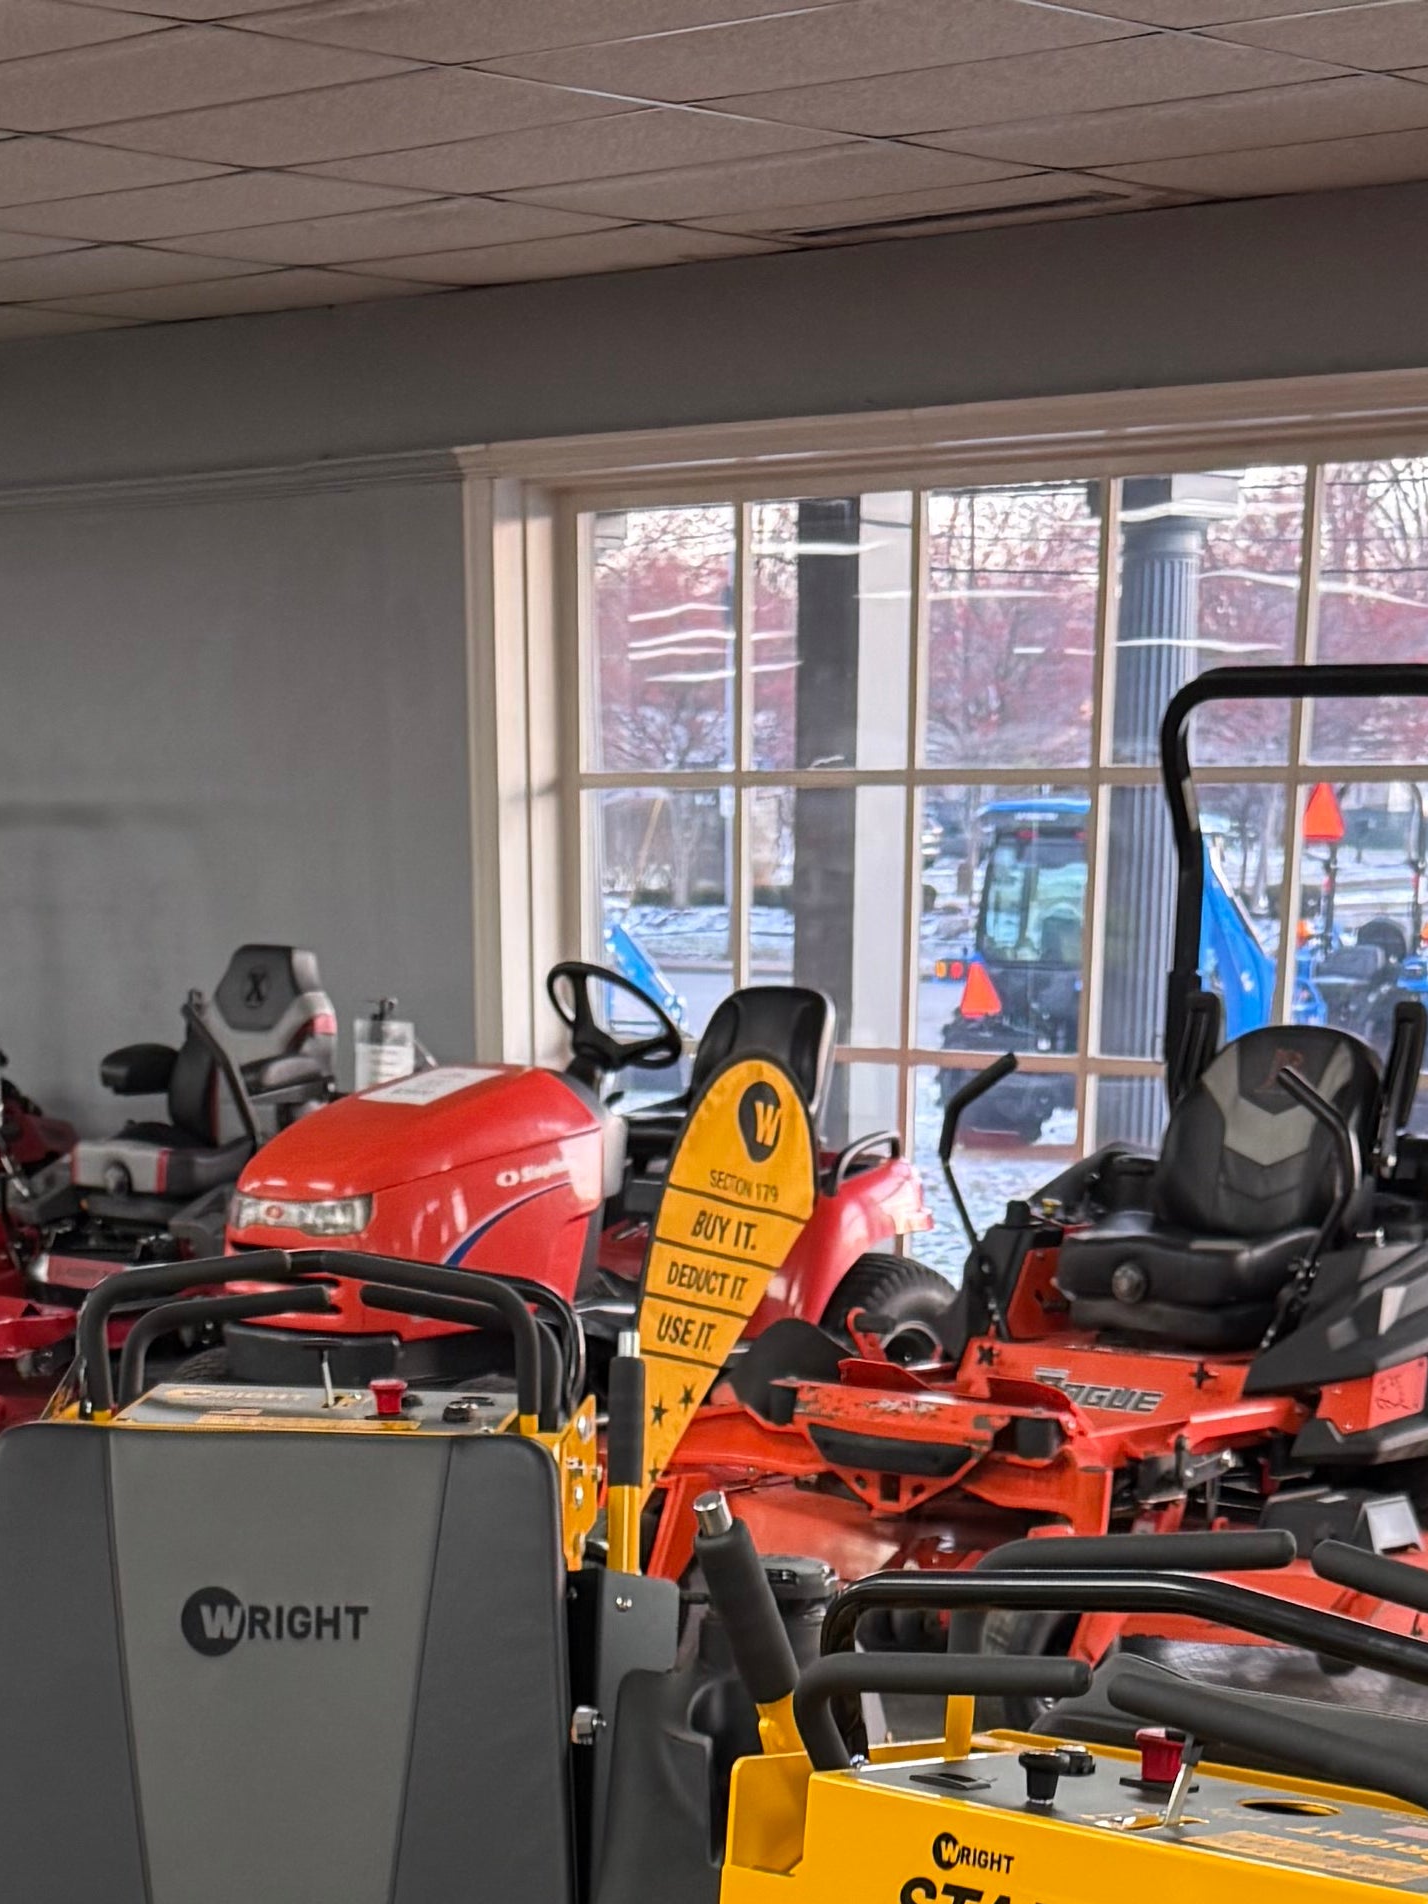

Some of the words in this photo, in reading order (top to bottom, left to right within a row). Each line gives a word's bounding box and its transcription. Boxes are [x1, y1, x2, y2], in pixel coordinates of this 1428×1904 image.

[755, 1182, 779, 1203] 179
[690, 1210, 730, 1242] BUY
[733, 1221, 758, 1251] IT.
[666, 1260, 731, 1296] DEDUCT
[656, 1312, 693, 1345] USE
[693, 1321, 717, 1352] IT.
[192, 1600, 372, 1643] WRIGHT
[936, 1834, 1016, 1875] WRIGHT
